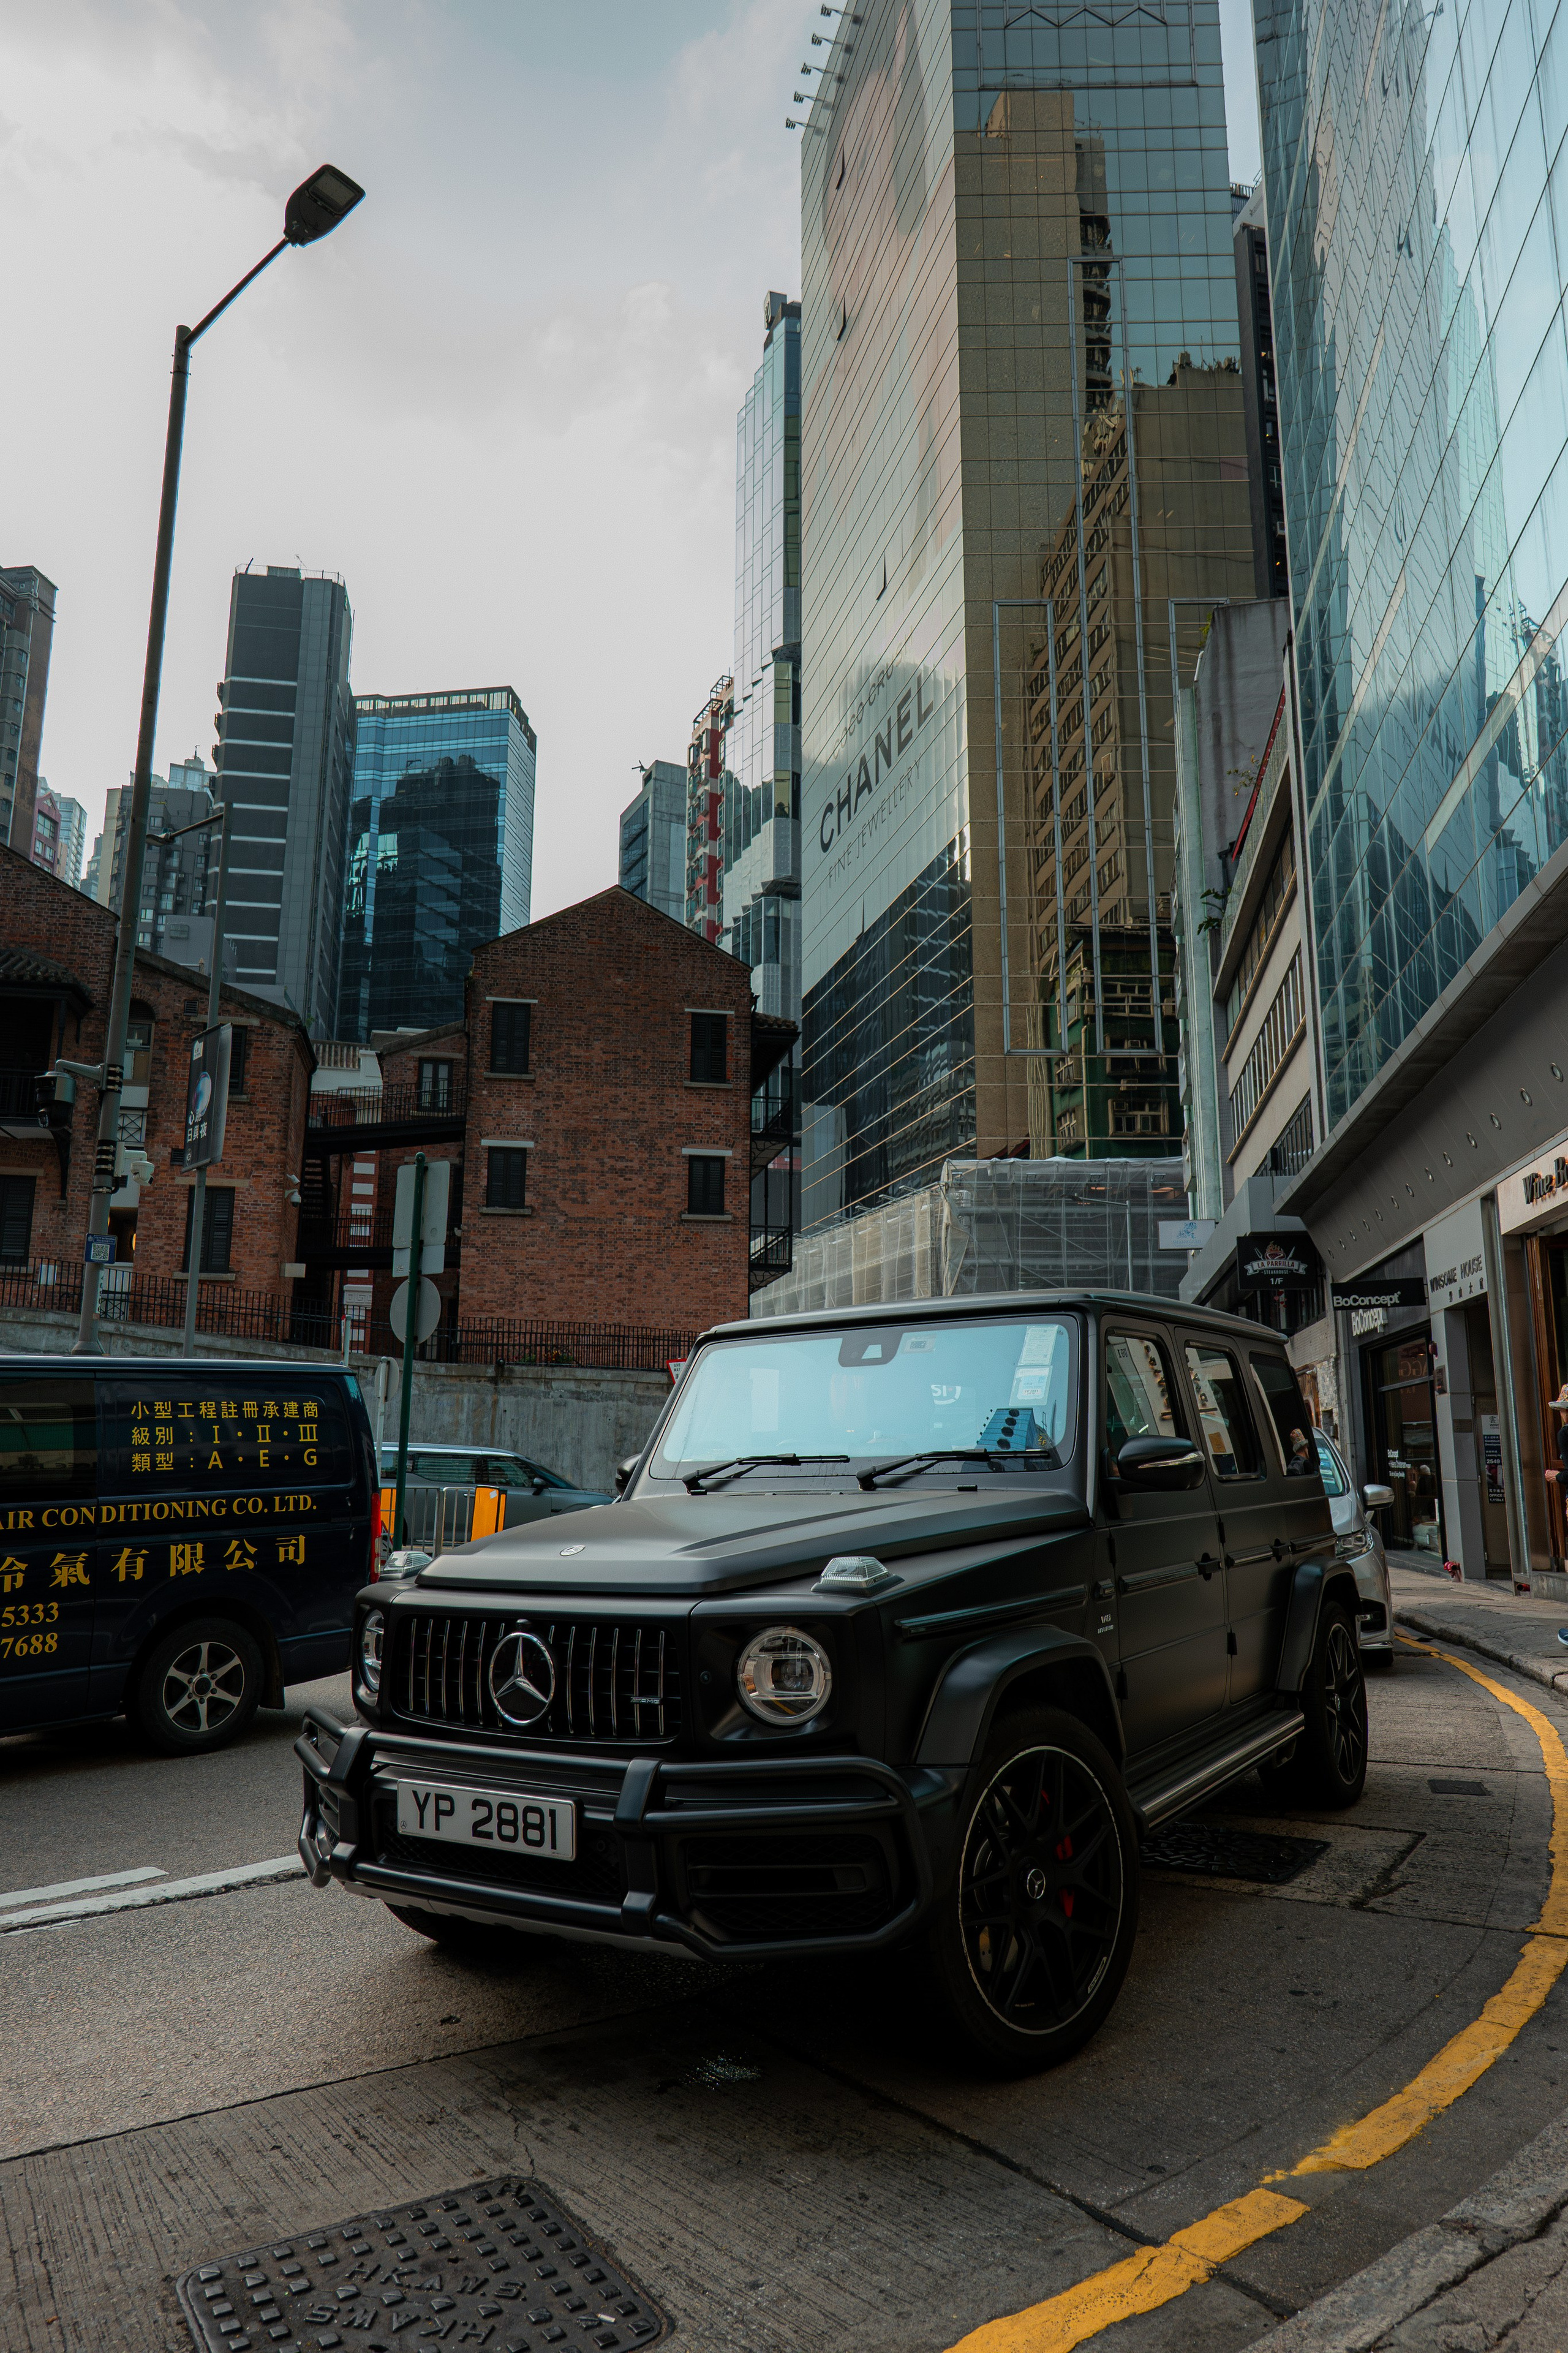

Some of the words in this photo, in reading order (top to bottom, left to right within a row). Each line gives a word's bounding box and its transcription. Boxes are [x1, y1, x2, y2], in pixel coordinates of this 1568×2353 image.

[833, 701, 864, 760] COCO
[820, 672, 933, 853] CHANEL
[829, 841, 852, 888] FINE
[856, 755, 922, 859] JEWELLERY
[1522, 1173, 1554, 1205] Wine
[1429, 1267, 1458, 1293] WINSOME
[1460, 1254, 1483, 1280] HOUSE
[1333, 1292, 1400, 1307] BoConcept
[131, 1401, 318, 1419] 小型工程註冊承建商
[42, 1498, 227, 1527] CONDITIONING
[233, 1497, 268, 1514] CO.
[274, 1494, 317, 1512] LTD.
[1, 1602, 59, 1628] 5333
[0, 1633, 58, 1658] 7688
[412, 1790, 454, 1832] YP
[471, 1799, 557, 1850] 2881
